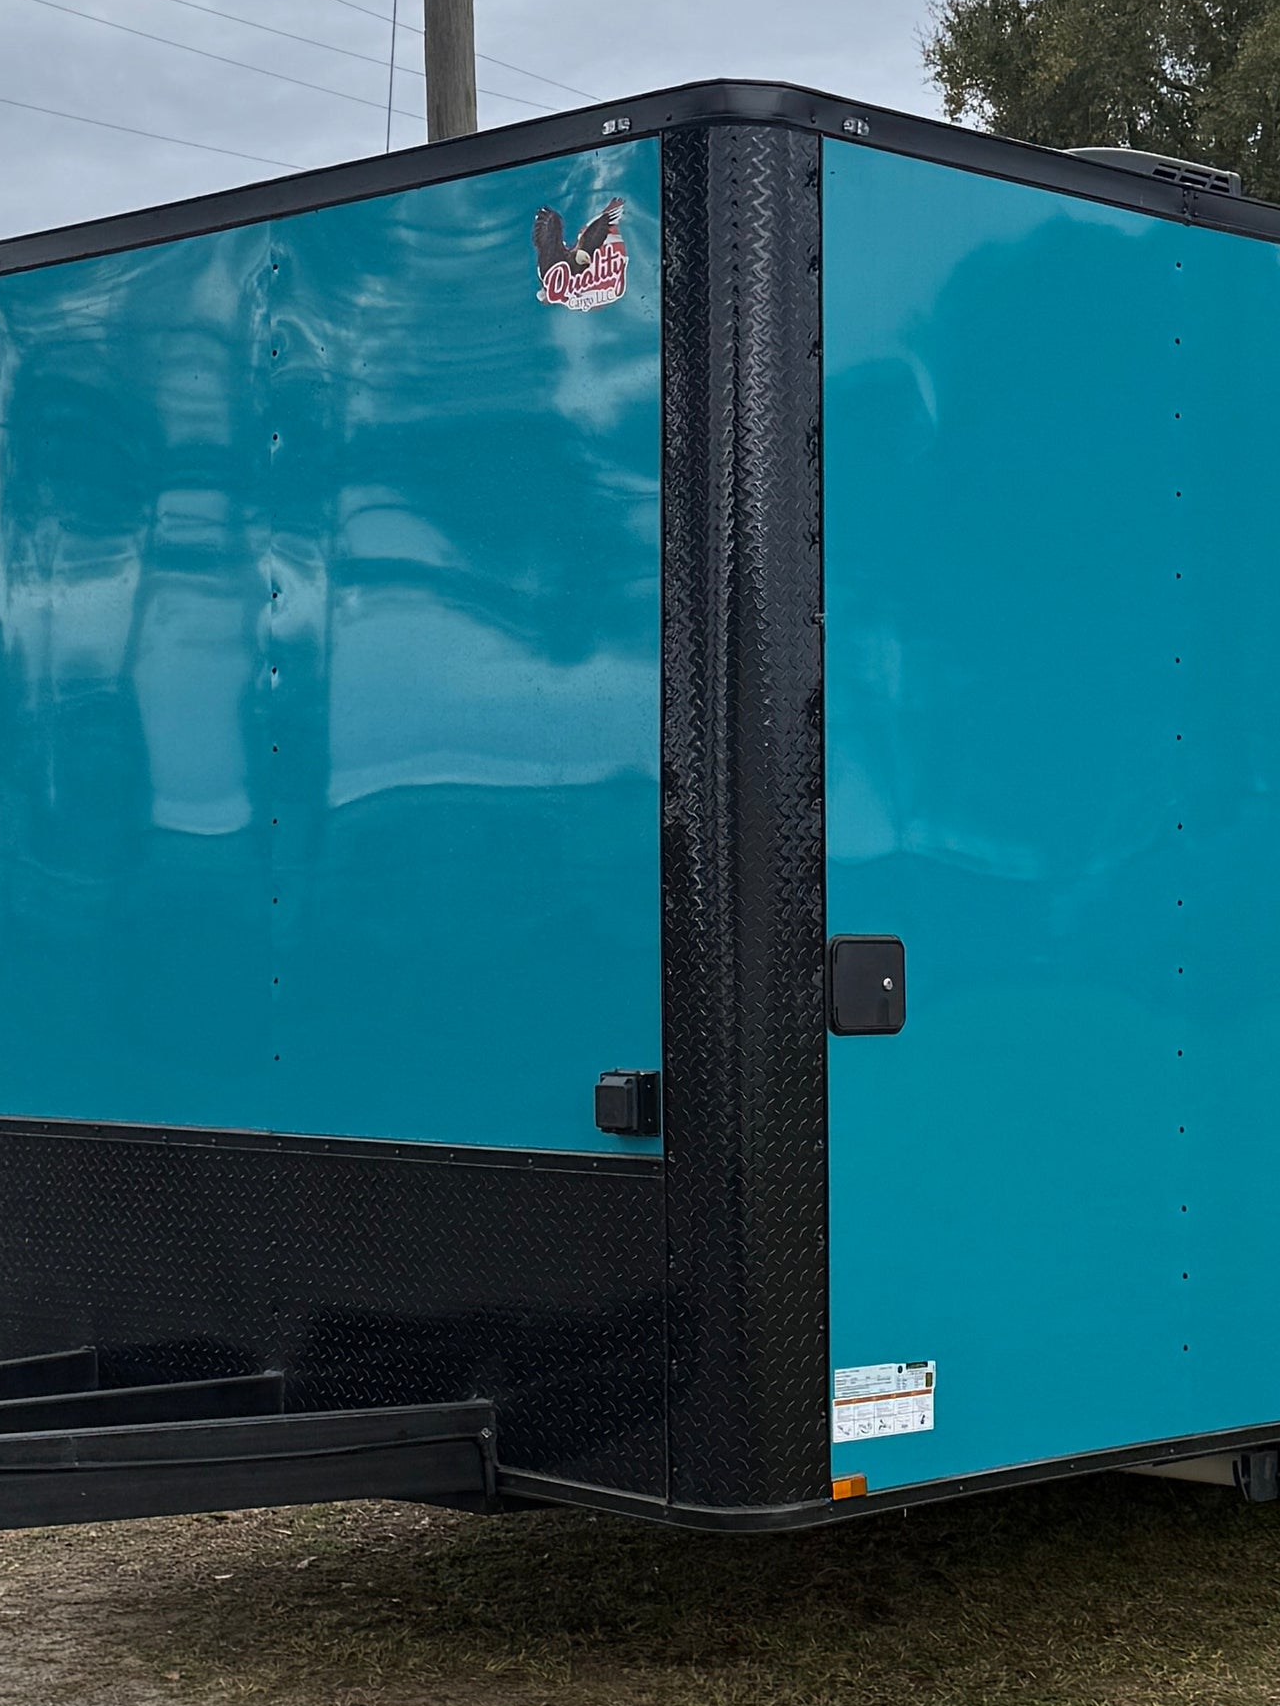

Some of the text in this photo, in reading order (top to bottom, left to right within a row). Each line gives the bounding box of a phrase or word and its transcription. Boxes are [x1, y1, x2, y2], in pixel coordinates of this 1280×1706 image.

[544, 245, 626, 303] Quality
[568, 288, 616, 310] Cargo LLC
